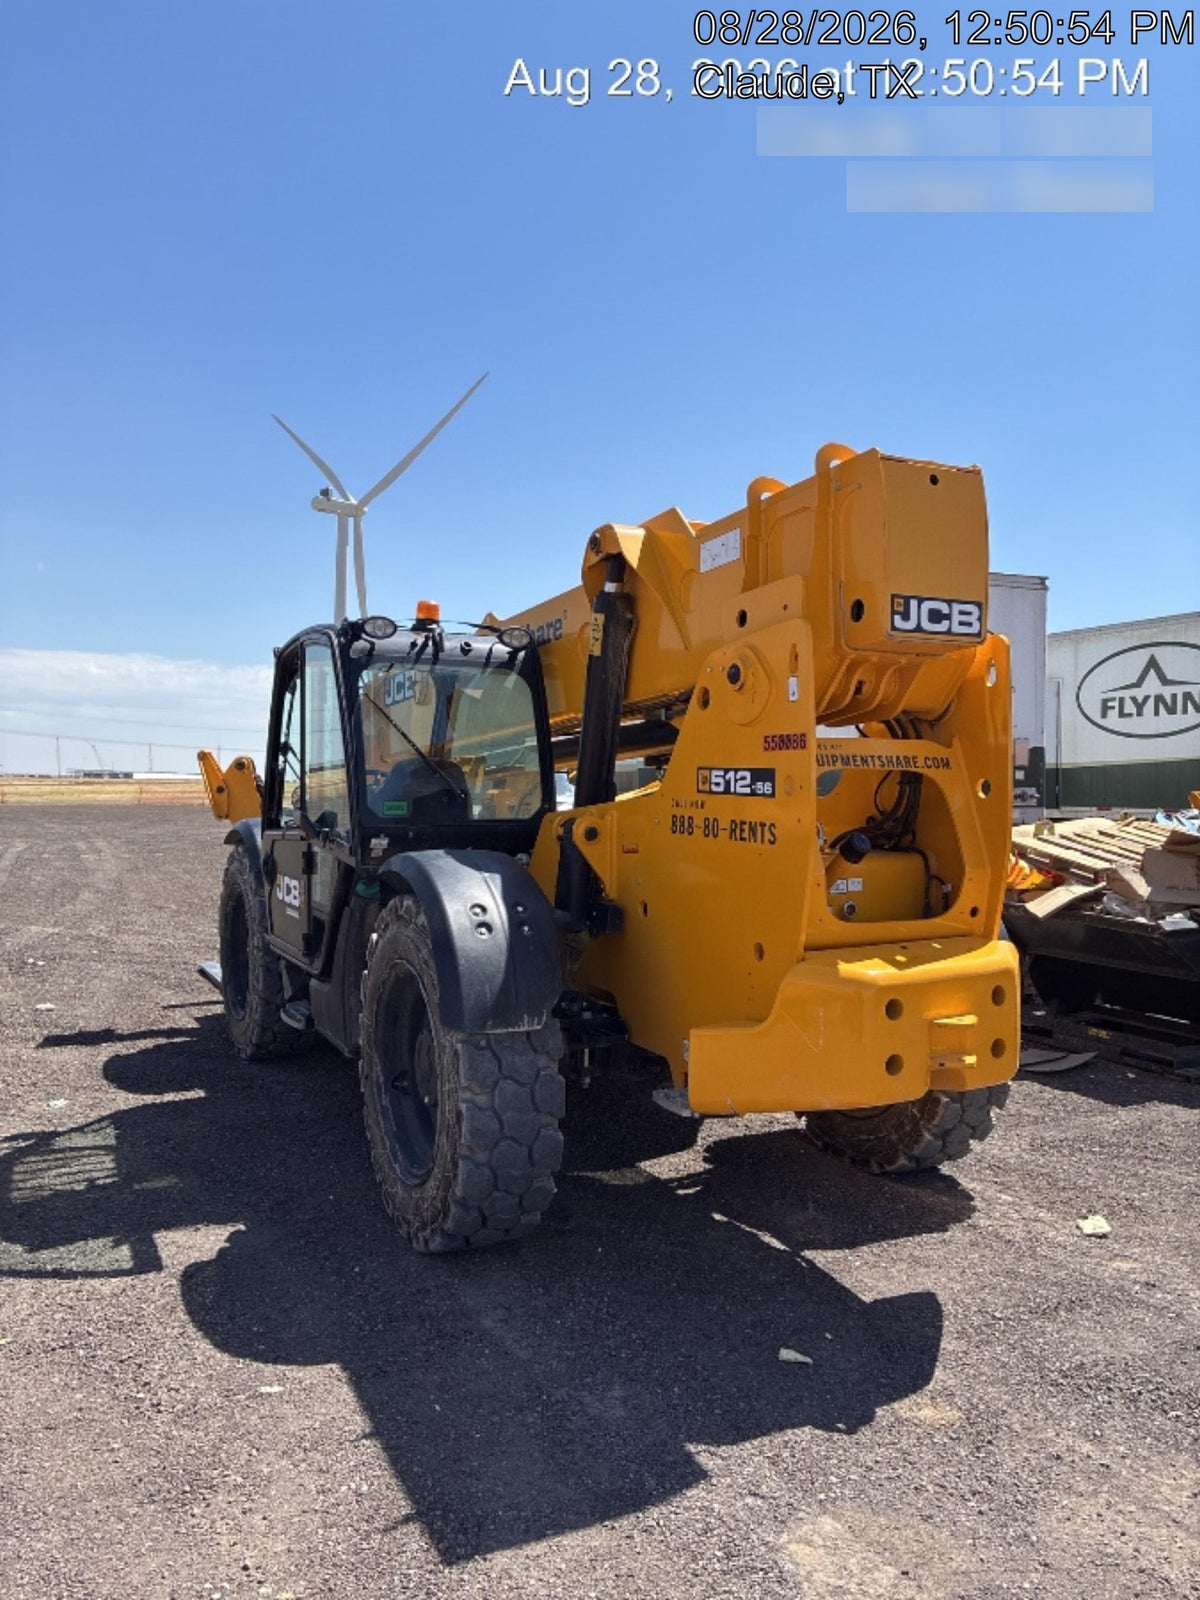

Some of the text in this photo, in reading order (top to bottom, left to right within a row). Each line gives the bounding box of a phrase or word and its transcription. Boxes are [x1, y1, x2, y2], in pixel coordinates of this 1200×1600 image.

[893, 598, 981, 634] JCB
[1100, 691, 1200, 719] FLYNN
[816, 753, 952, 769] UIPMENTSHARE.COM
[671, 814, 777, 845] 888-80-RENTS
[276, 874, 300, 907] JCB
